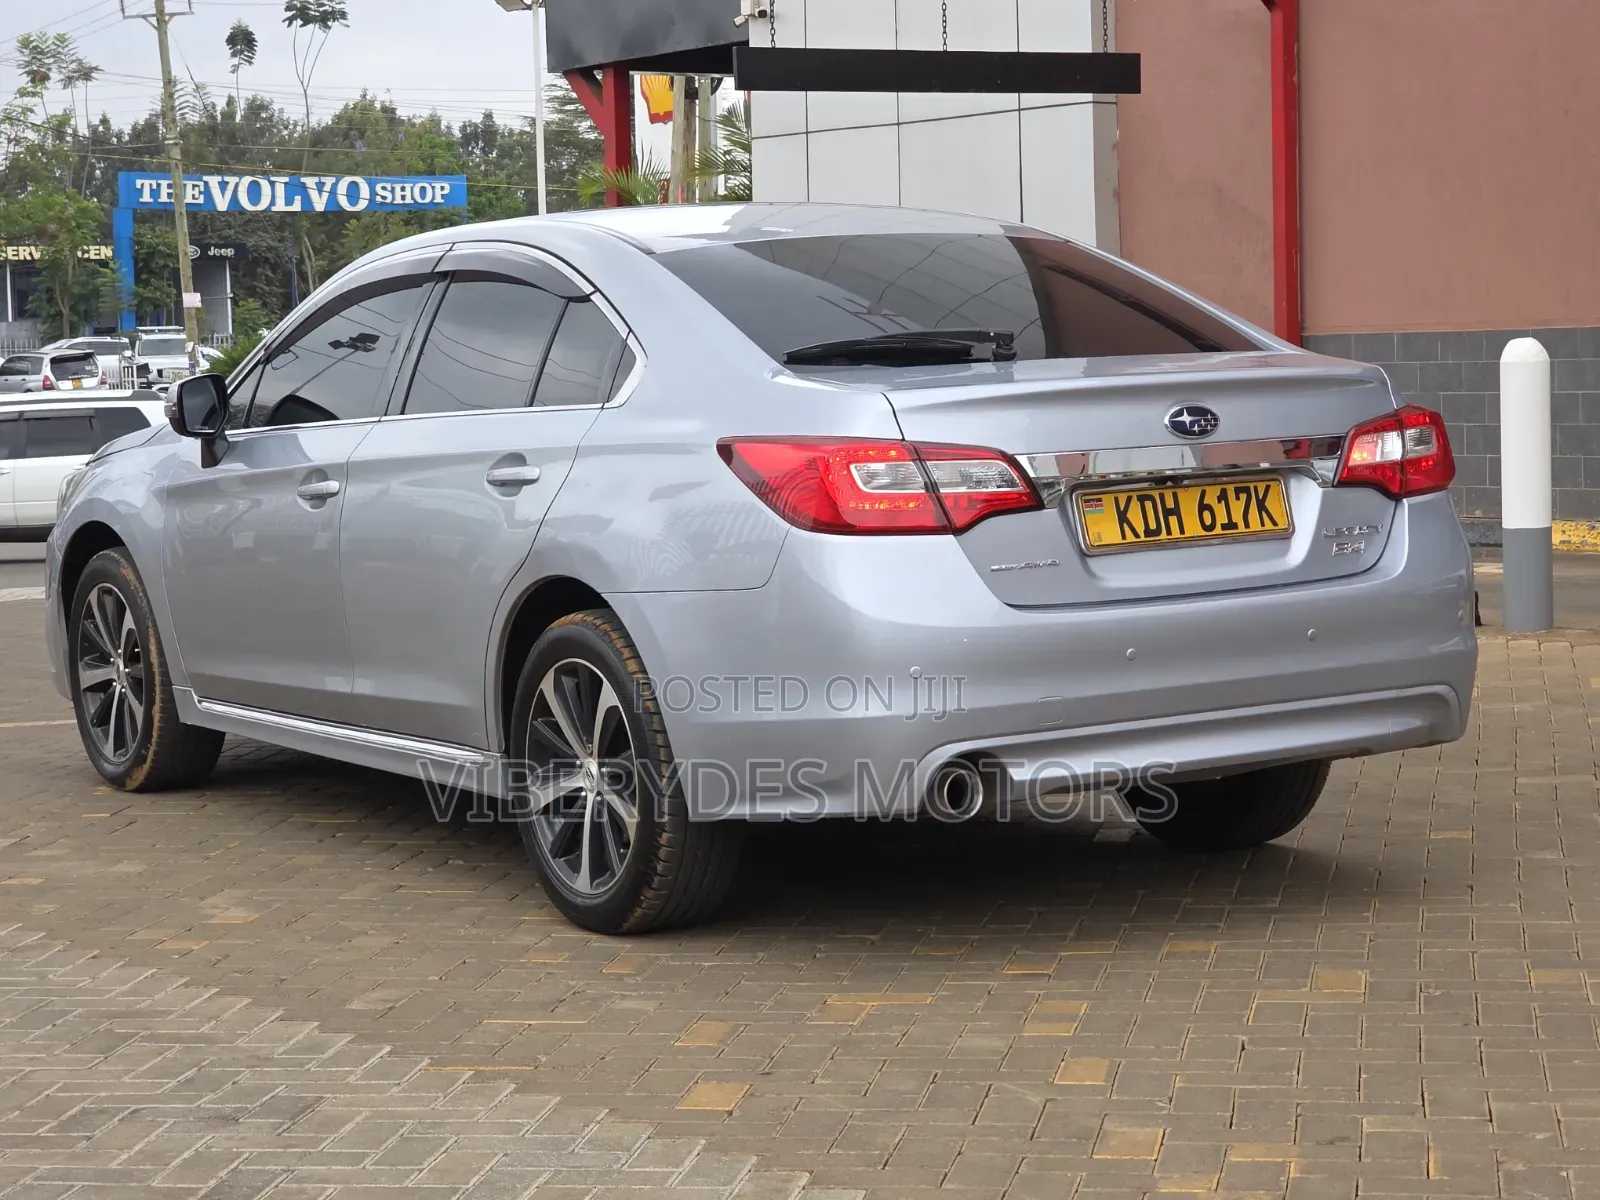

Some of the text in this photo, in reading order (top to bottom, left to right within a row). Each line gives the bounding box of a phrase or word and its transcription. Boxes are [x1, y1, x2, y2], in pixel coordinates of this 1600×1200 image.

[135, 175, 451, 212] THE VOLVO SHOP
[207, 245, 236, 258] Jeep
[1113, 491, 1186, 541] KDH
[1197, 483, 1279, 533] 617K
